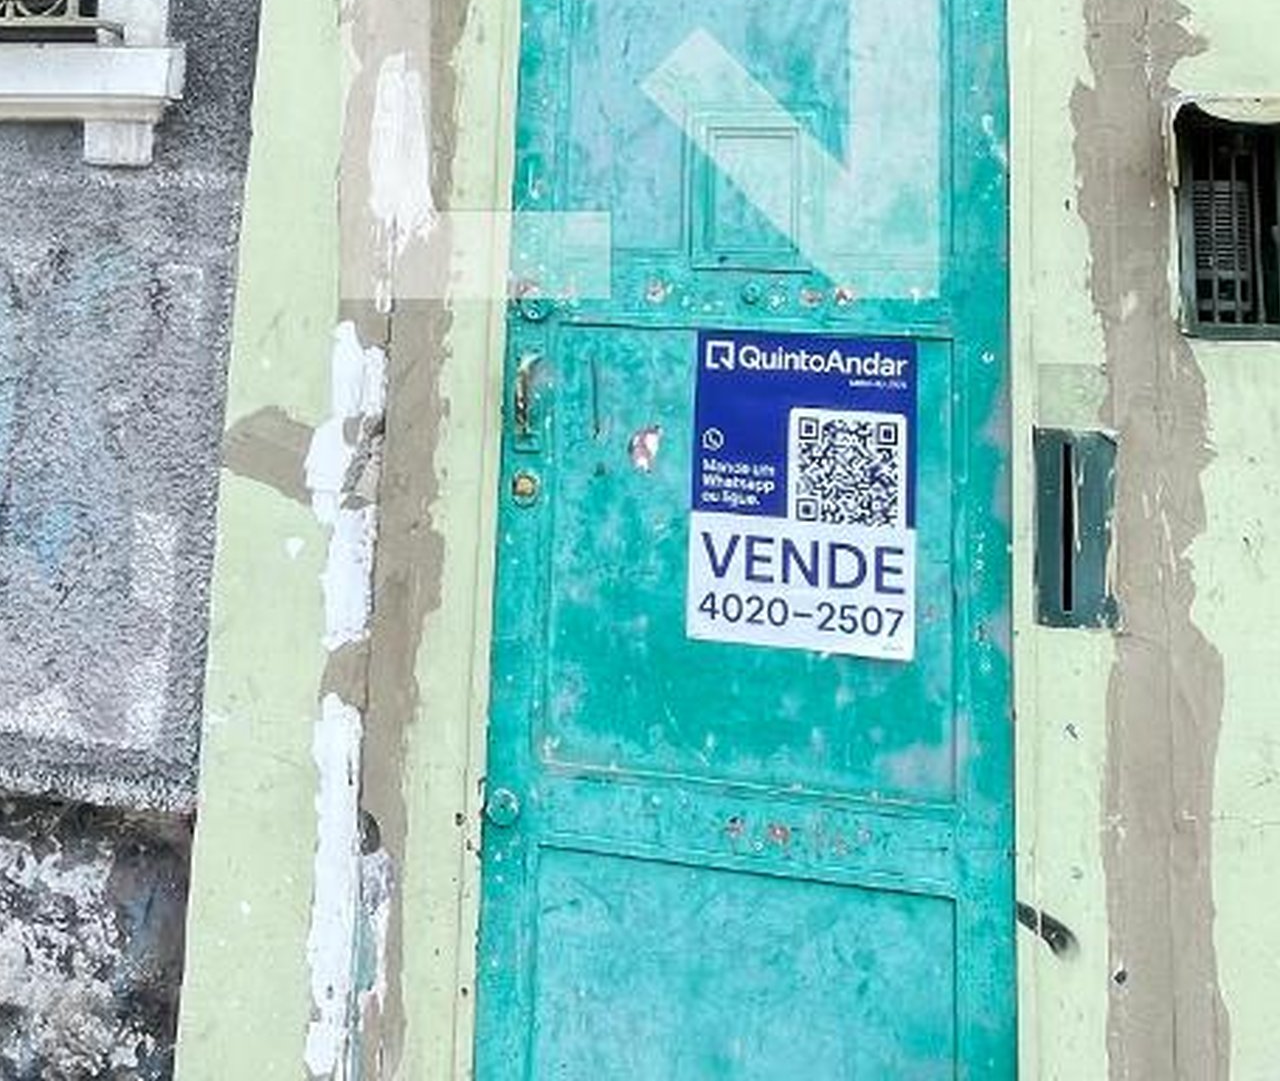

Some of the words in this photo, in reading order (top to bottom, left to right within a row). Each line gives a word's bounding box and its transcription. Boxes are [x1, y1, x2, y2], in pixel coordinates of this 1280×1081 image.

[738, 345, 909, 377] QuintoAndar
[701, 531, 907, 595] VENDE
[698, 591, 905, 638] 4020-2507
